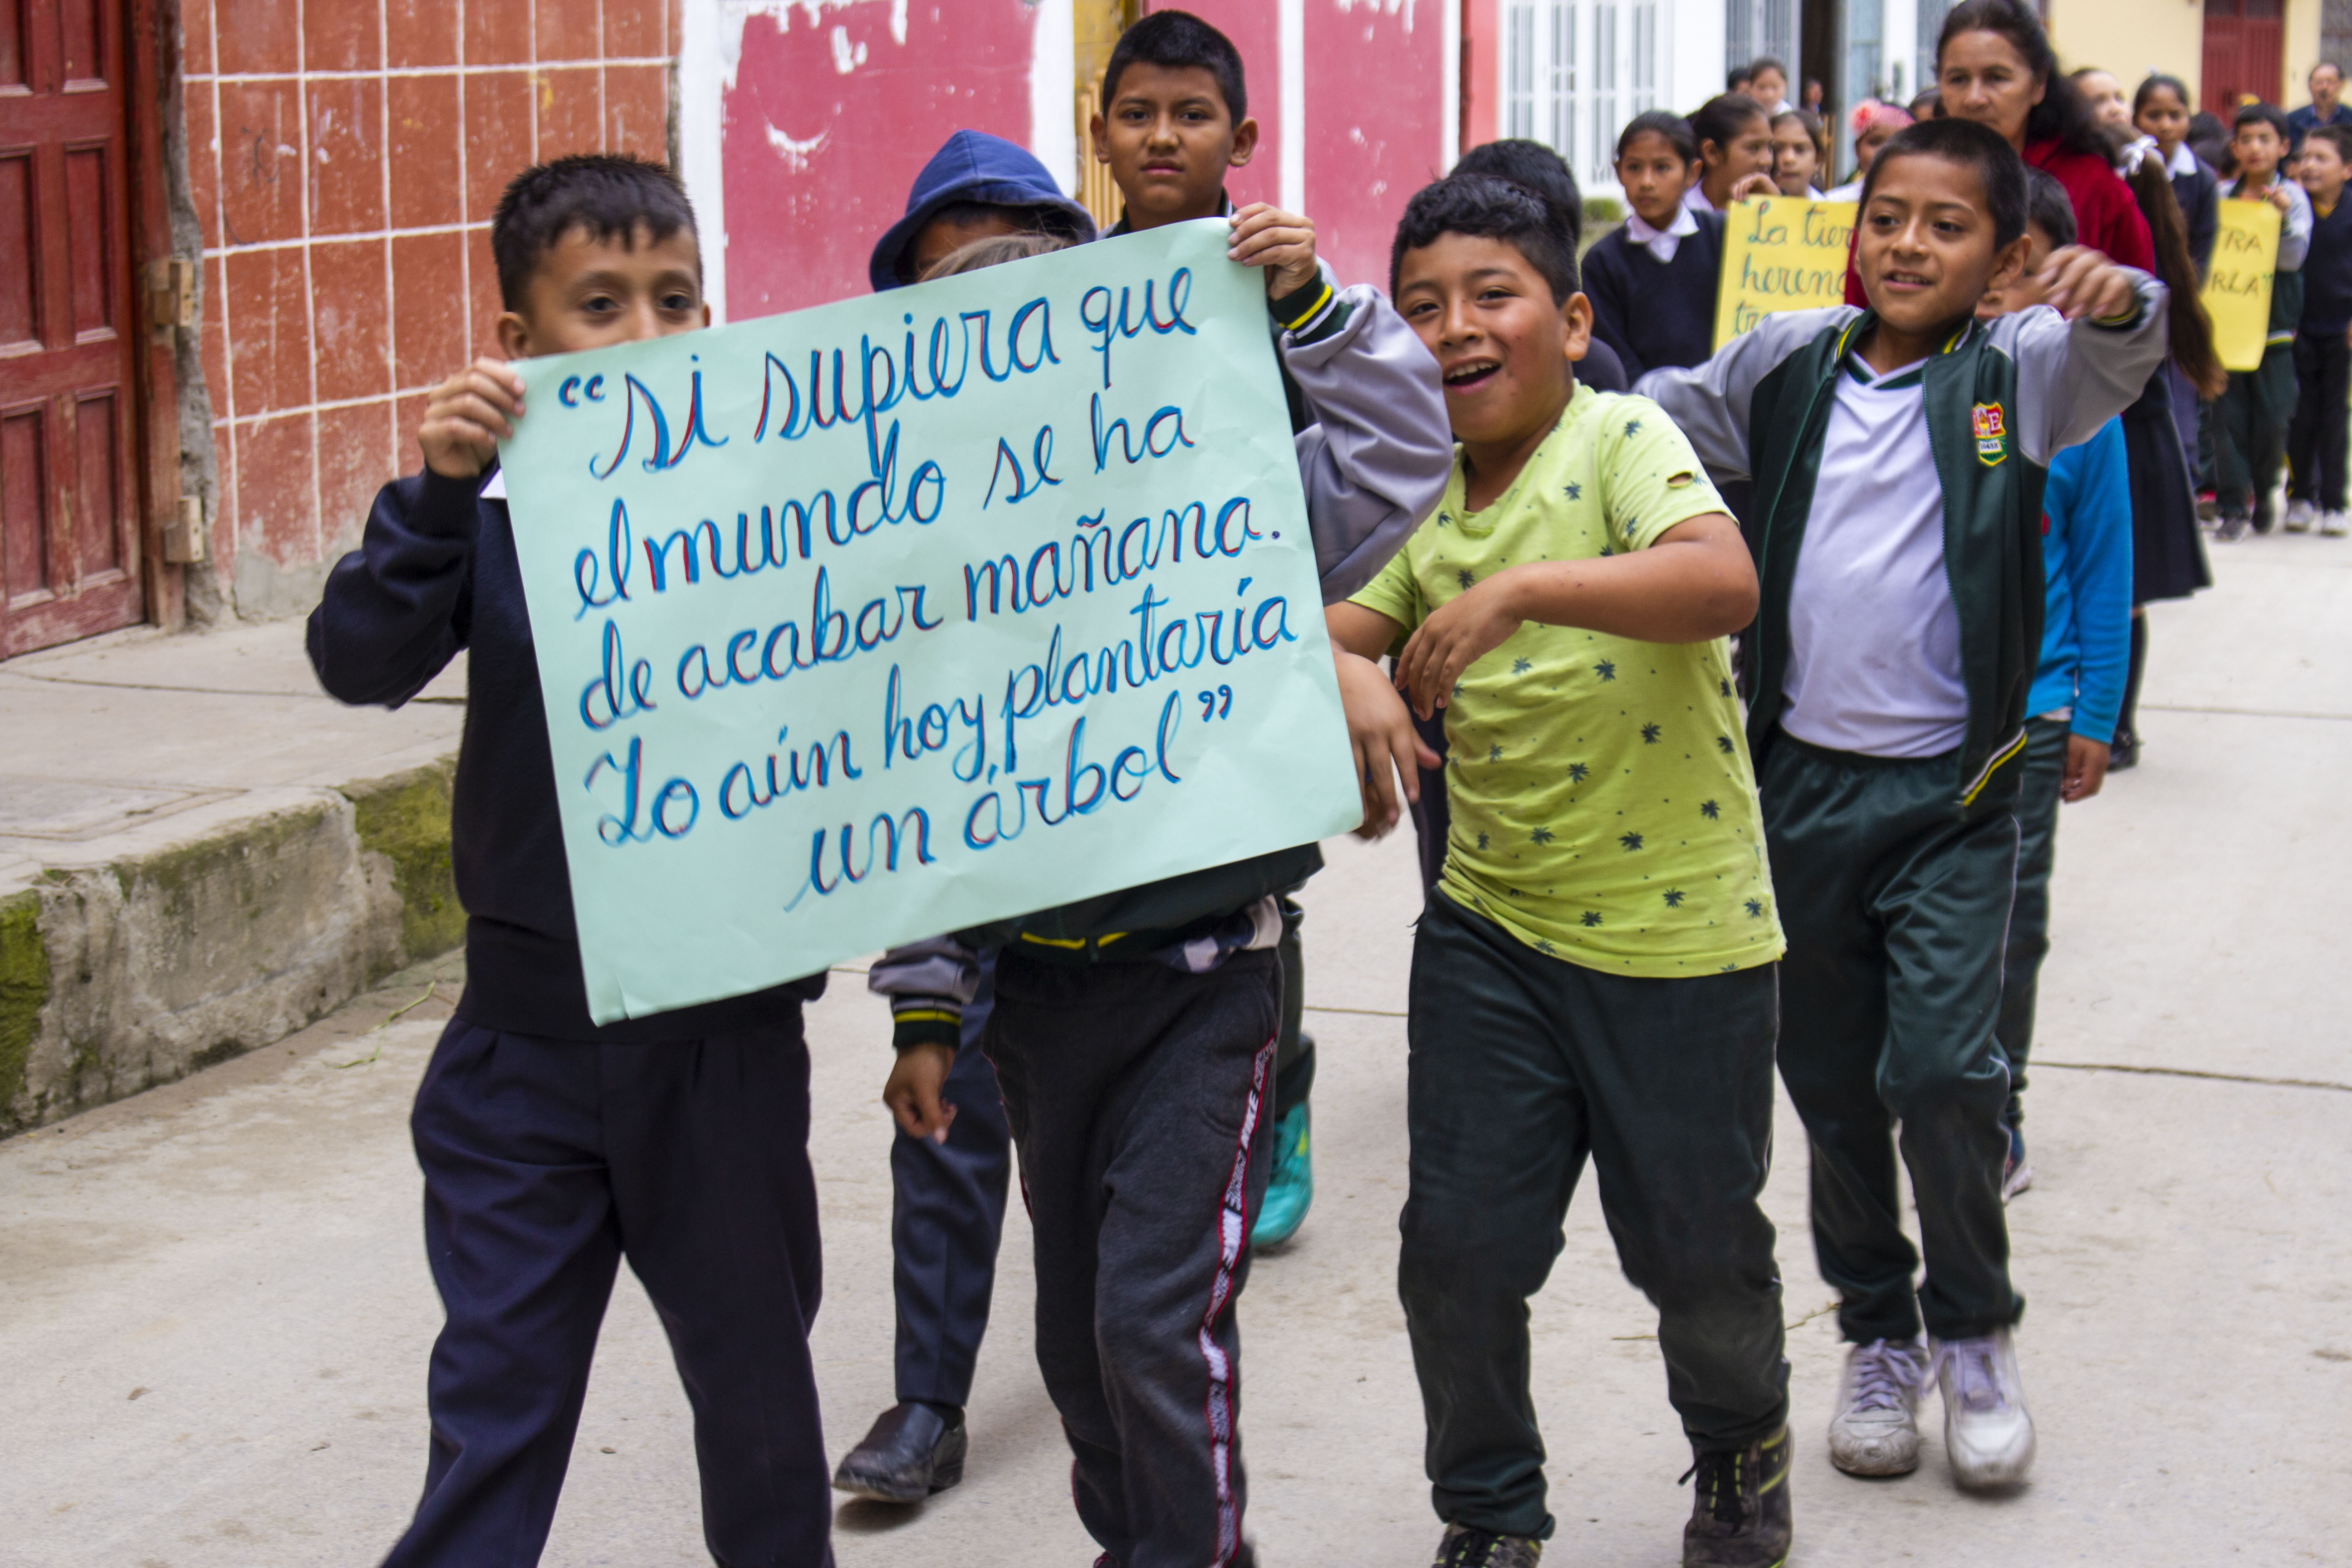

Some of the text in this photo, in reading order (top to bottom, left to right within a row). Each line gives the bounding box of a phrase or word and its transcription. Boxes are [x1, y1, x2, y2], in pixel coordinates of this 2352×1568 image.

[755, 296, 1061, 484] supiera
[1079, 267, 1197, 391] que
[983, 425, 1063, 510] se
[1091, 392, 1195, 475] ha
[579, 618, 657, 732] de
[676, 565, 944, 700] acabar
[719, 725, 862, 821] aún
[1000, 577, 1298, 775] plantaría
[784, 806, 936, 912] un
